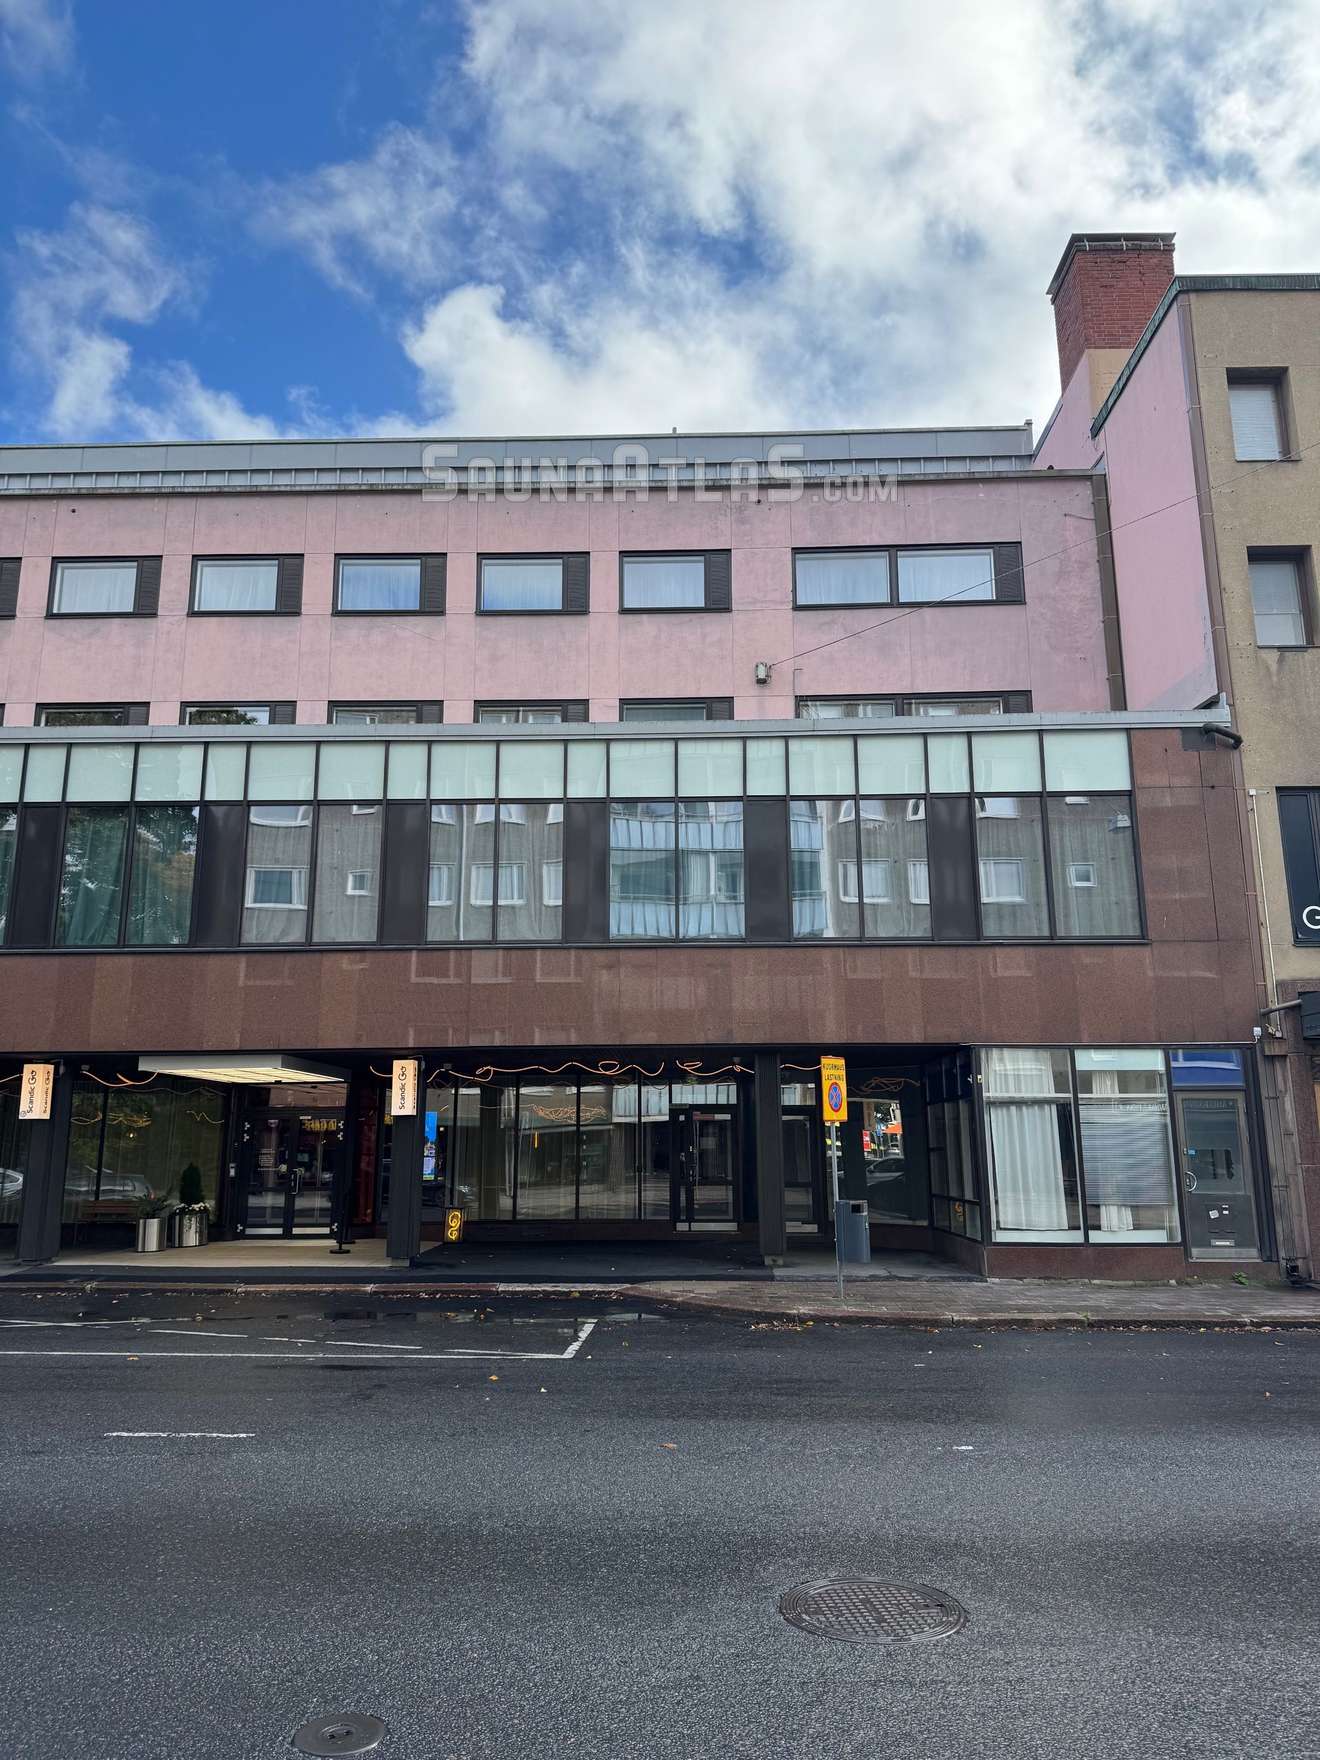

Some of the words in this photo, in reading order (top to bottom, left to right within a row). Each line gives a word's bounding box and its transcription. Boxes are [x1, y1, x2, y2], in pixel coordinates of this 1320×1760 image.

[397, 1065, 407, 1081] Go
[26, 1085, 36, 1114] Scandic
[398, 1082, 407, 1110] Scandic
